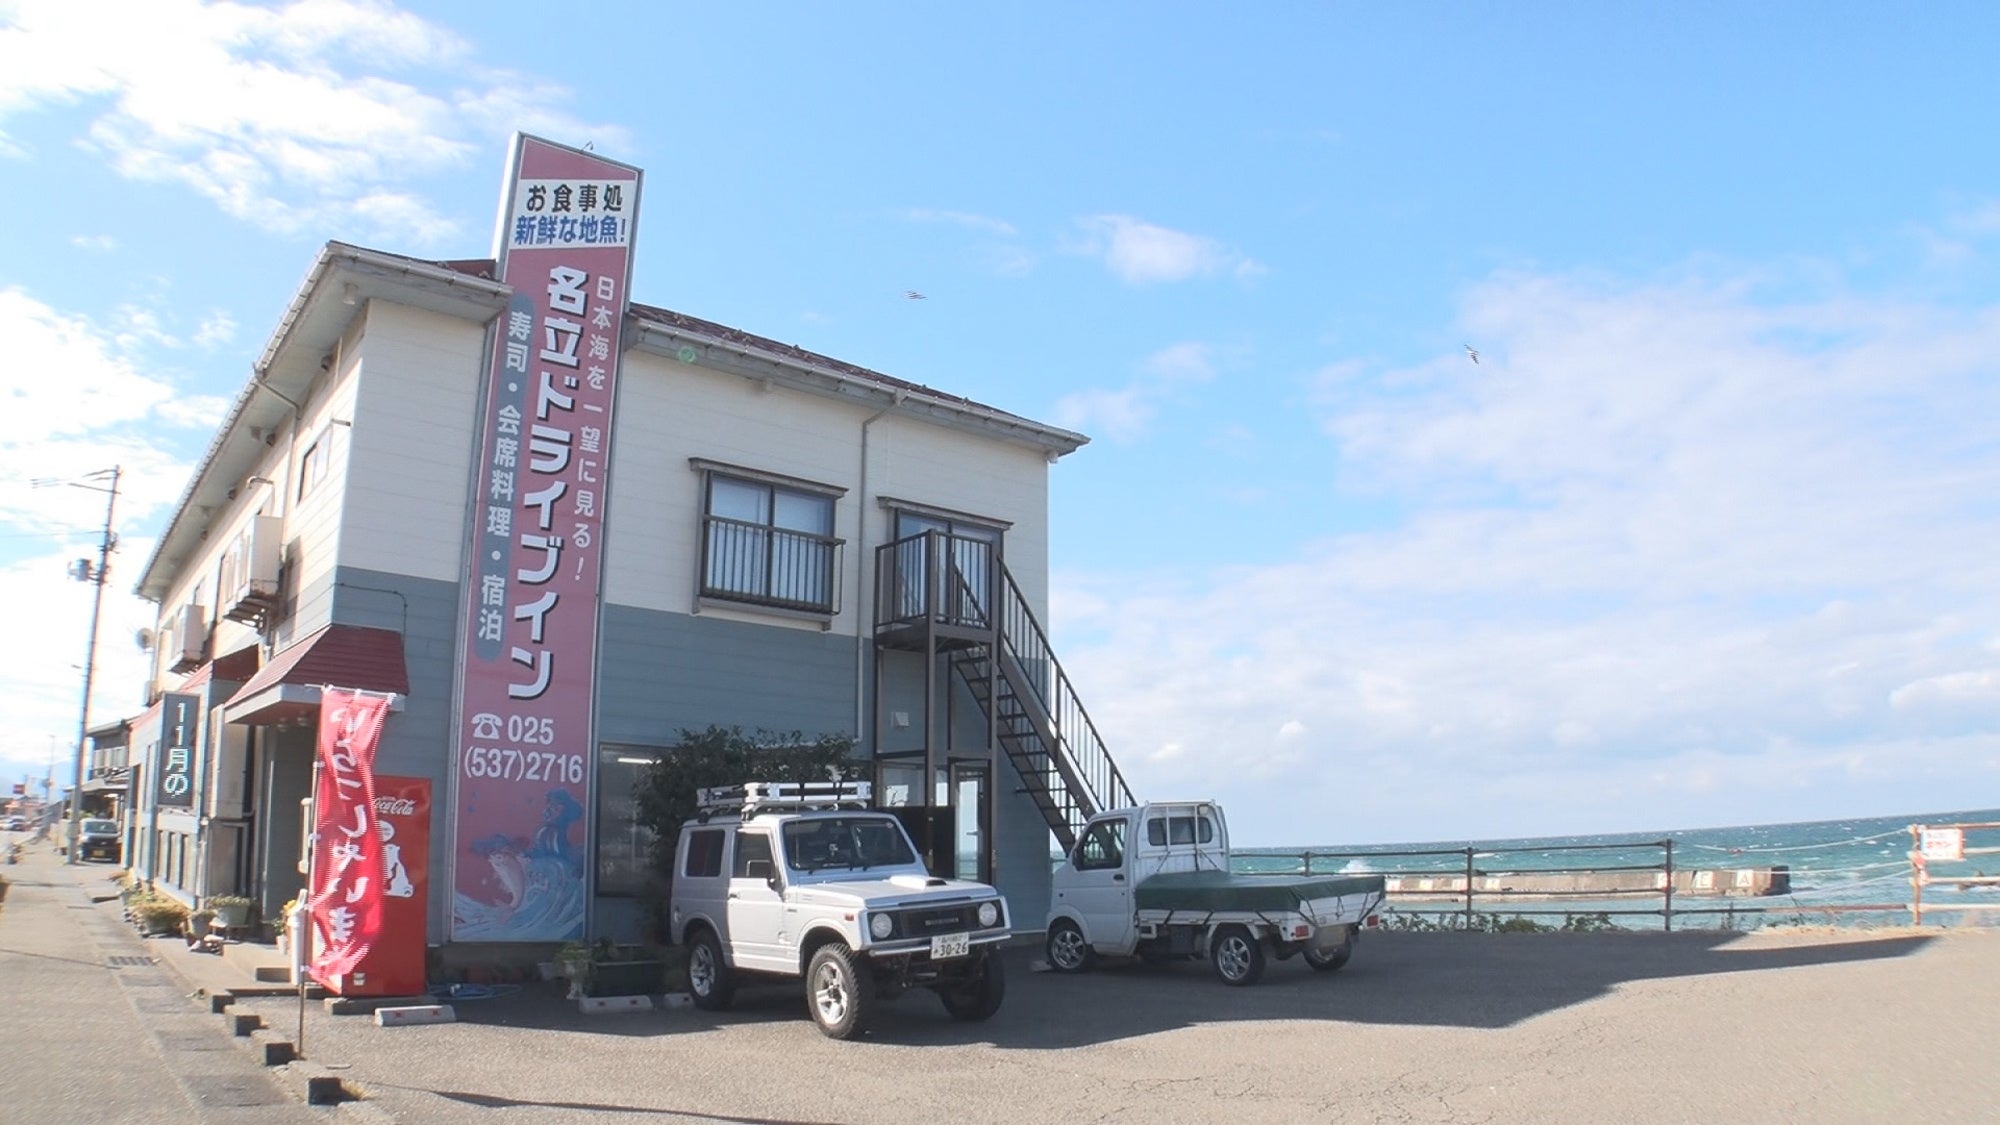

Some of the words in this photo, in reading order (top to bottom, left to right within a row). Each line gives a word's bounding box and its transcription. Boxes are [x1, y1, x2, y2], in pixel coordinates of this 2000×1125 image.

[526, 184, 623, 213] お食事処
[514, 215, 626, 245] 新鮮な地魚!
[572, 275, 614, 581] 日本海を一望に見る!
[508, 265, 589, 699] 名立ドライブイン
[508, 715, 554, 745] 025
[165, 702, 189, 799] 11月の
[464, 746, 583, 784] (537)2716
